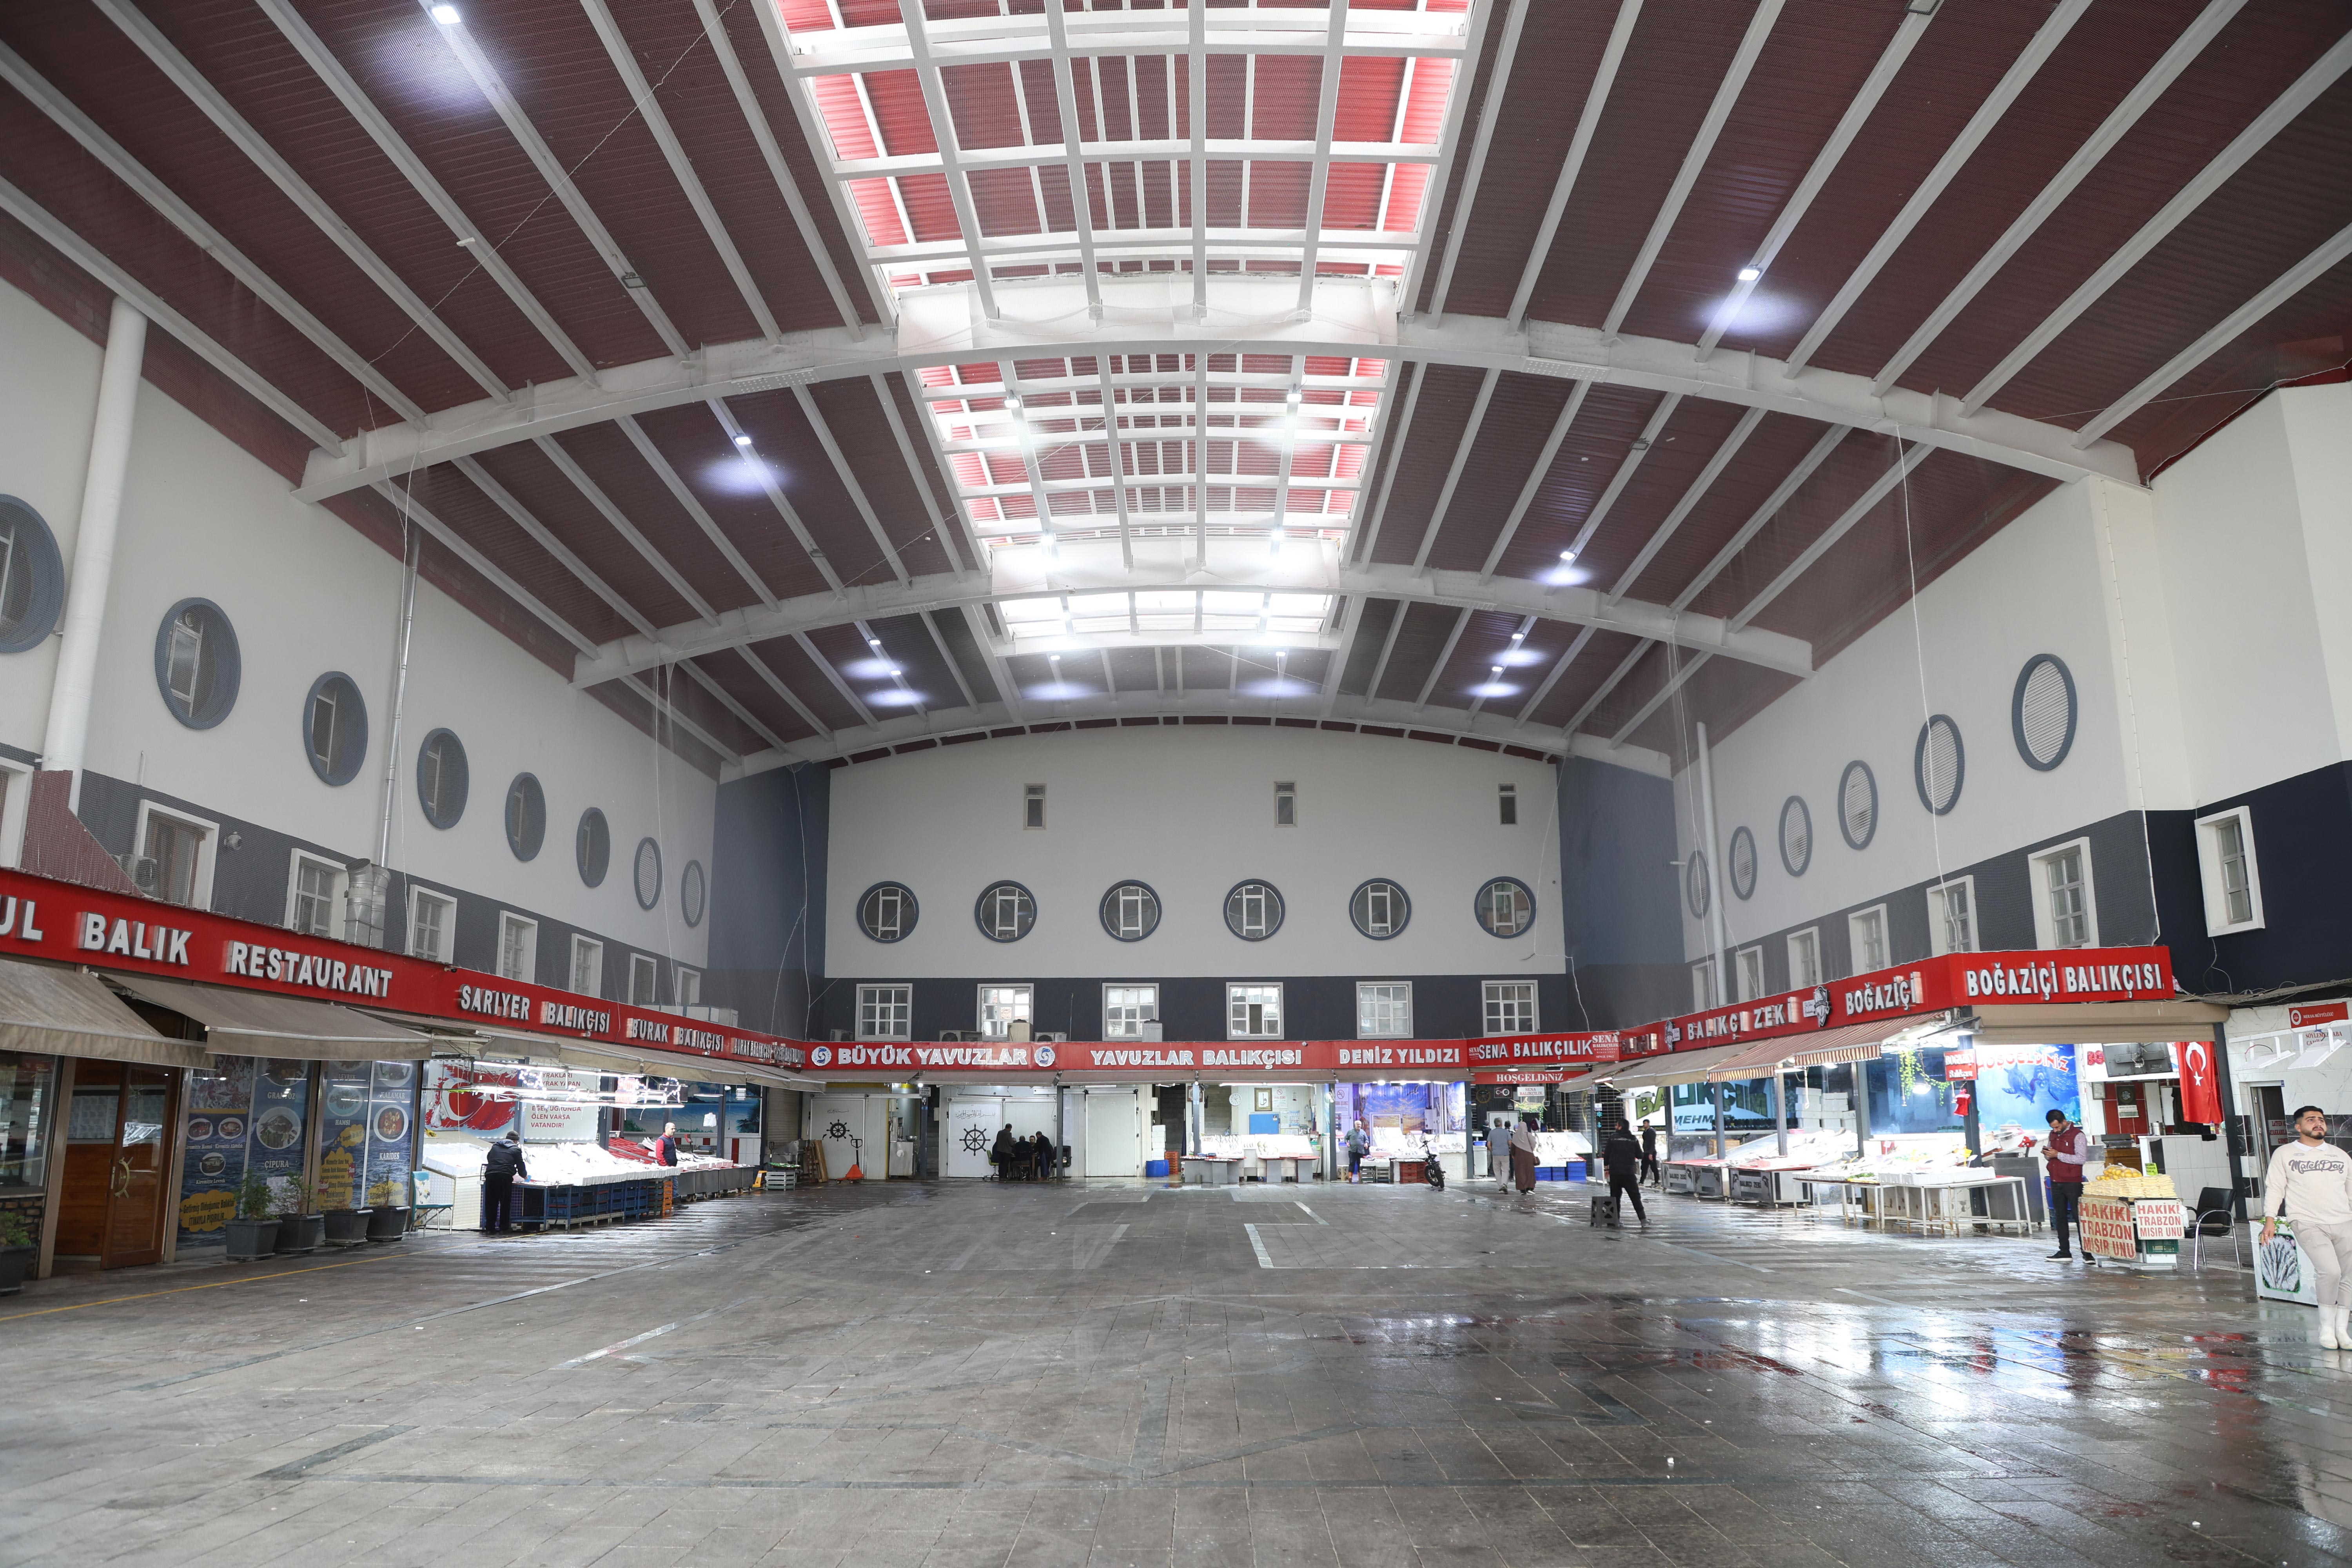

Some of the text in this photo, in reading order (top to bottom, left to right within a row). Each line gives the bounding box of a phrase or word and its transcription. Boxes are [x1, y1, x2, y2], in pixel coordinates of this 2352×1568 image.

[81, 911, 192, 965] BALIK
[227, 940, 392, 998] RESTAURANT
[1967, 961, 2163, 1001] BOĞAZİÇİ BALIKÇISI
[460, 984, 530, 1020] SARIYER
[1845, 972, 1918, 1016] BOĞAZİÇİ
[1688, 1012, 1745, 1040] BALIKÇI
[1754, 997, 1794, 1029] ZEKİ
[632, 1018, 724, 1055] BURAK BALIKÇISI
[1592, 1034, 1619, 1043] SENA
[838, 1045, 1027, 1065] BÜYÜK YAVUZLAR
[1091, 1050, 1301, 1069] YAVUZLAR BALIKÇISI
[1340, 1046, 1392, 1064] DENİZ
[1397, 1048, 1459, 1063] YILDIZI
[1479, 1040, 1594, 1060] SENA BALIKÇILIK
[267, 1091, 296, 1100] GRANÖZ
[1674, 1115, 1715, 1124] MEHM
[264, 1159, 289, 1170] ÇİPURA
[379, 1151, 400, 1160] KARİDES
[2079, 1202, 2131, 1222] HAKIKI
[2137, 1202, 2180, 1214] HAKİKİ
[2080, 1220, 2132, 1241] TRABZON
[2139, 1216, 2181, 1226] TRABZON
[2140, 1227, 2182, 1237] MISIR UNU
[2083, 1236, 2134, 1258] MISIR UNU
